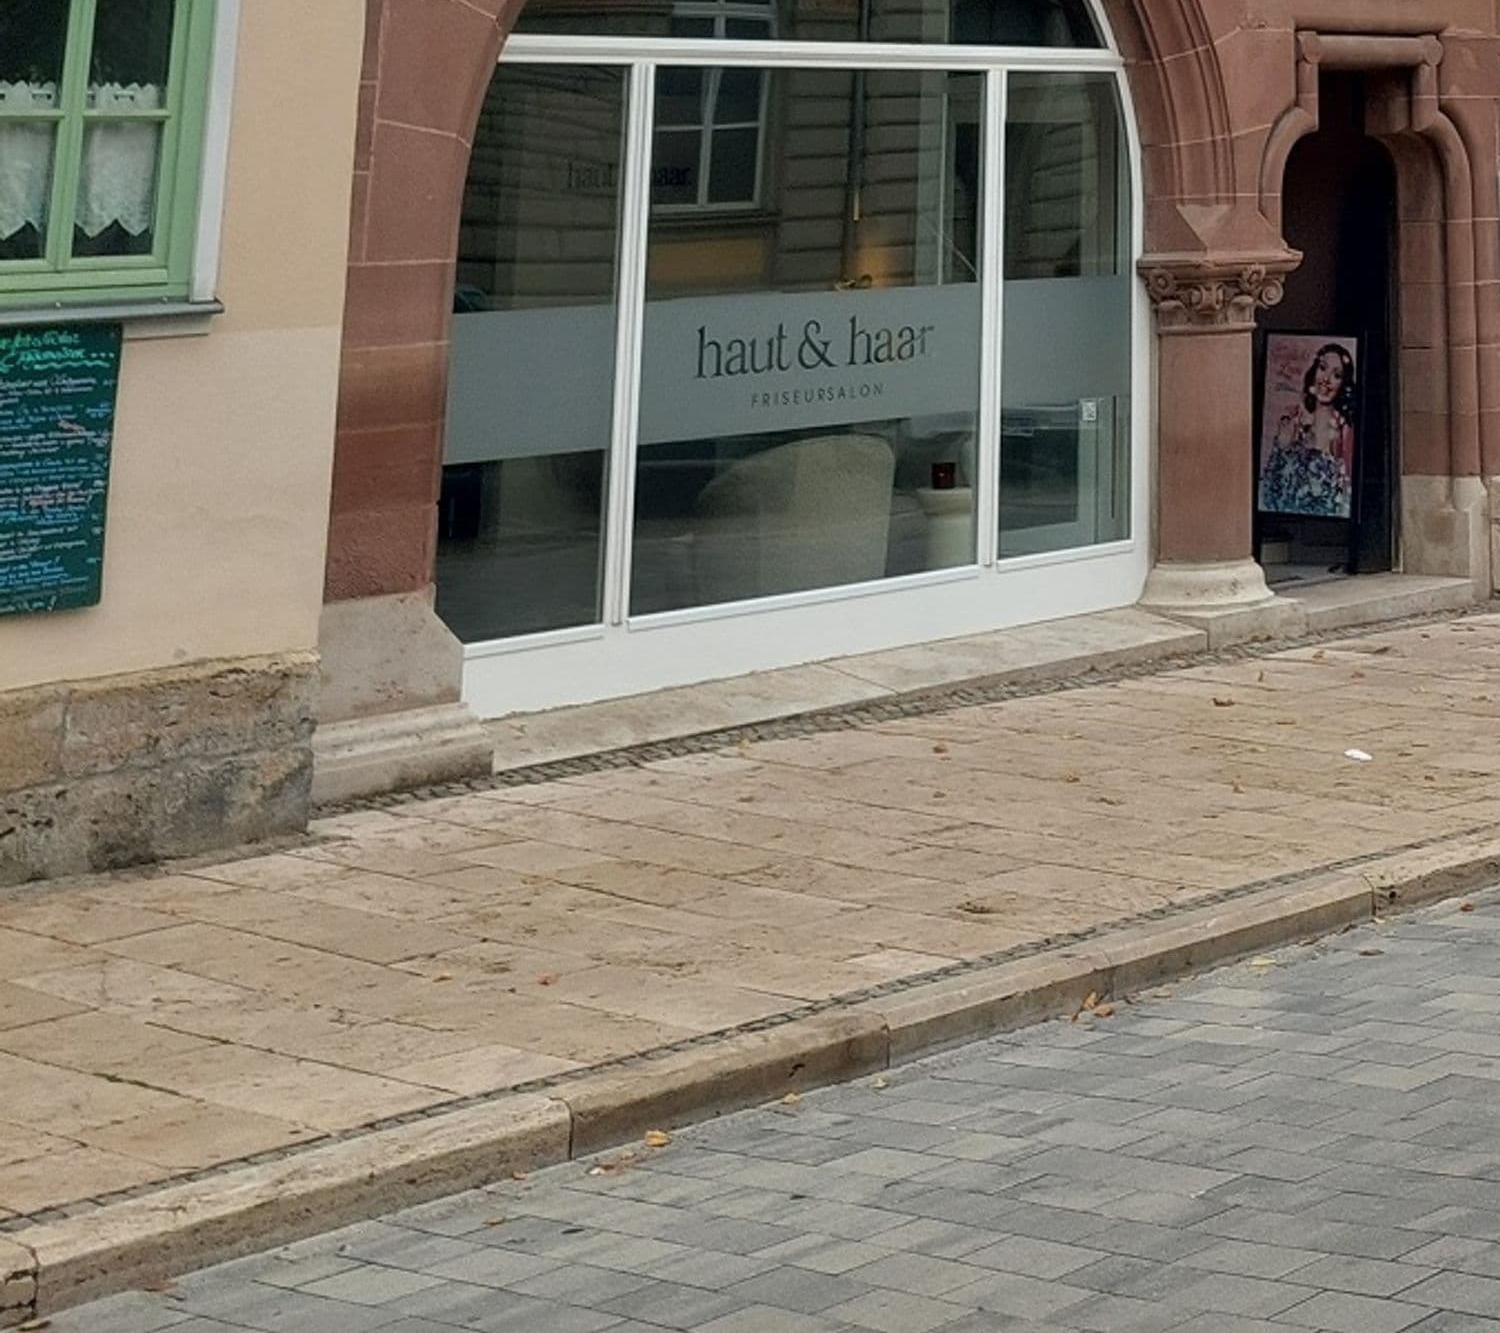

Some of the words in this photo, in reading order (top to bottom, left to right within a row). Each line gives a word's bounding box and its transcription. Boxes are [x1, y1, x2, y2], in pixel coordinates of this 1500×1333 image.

[696, 323, 790, 379] haut
[798, 319, 838, 370] &
[750, 382, 884, 409] FRISEURSALON
